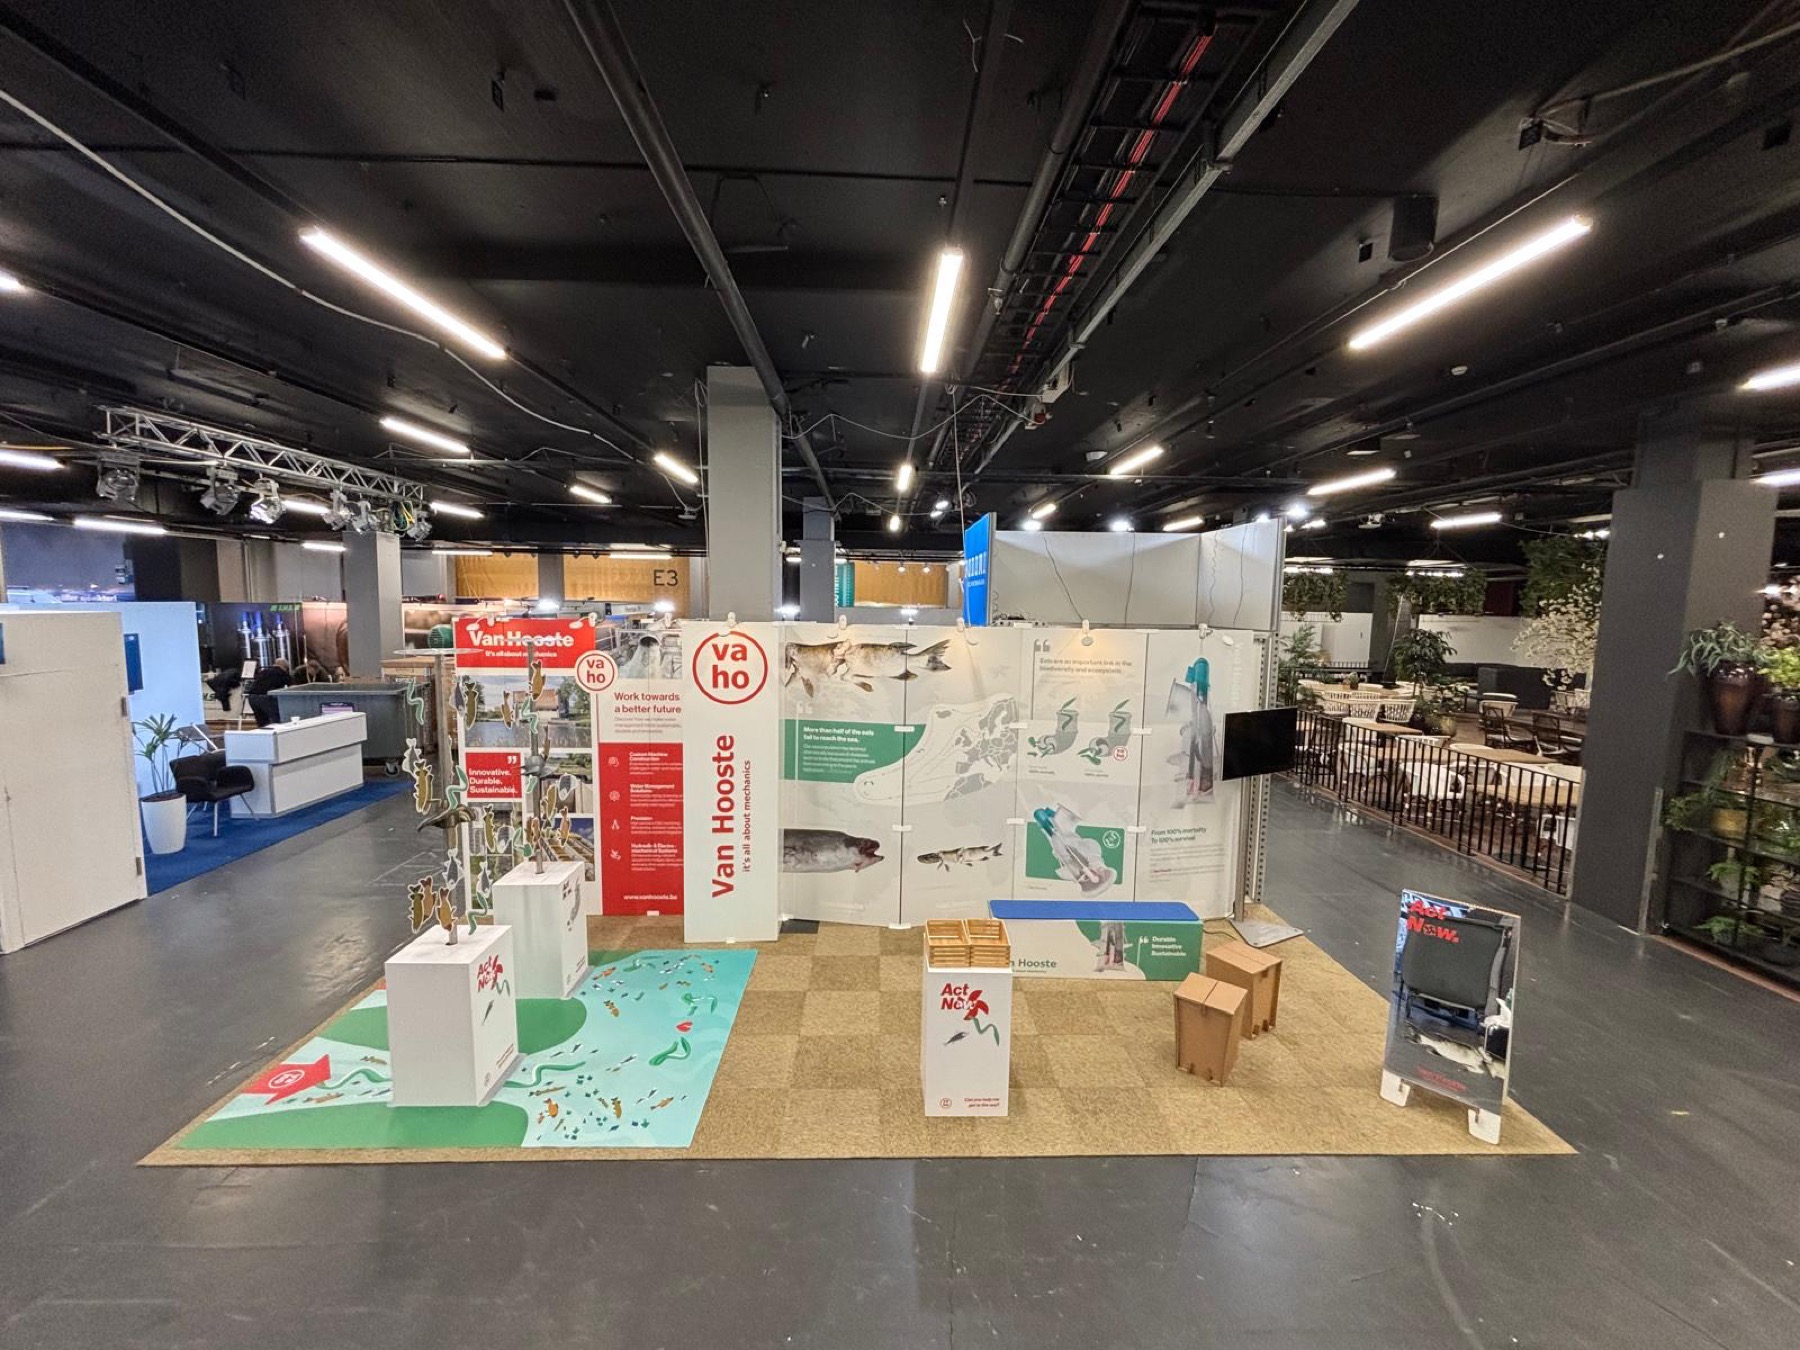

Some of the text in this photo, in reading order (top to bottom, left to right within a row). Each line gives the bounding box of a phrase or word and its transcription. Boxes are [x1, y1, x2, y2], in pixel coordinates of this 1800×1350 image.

[654, 570, 678, 586] E3
[468, 630, 575, 647] Van Hooste
[711, 643, 748, 661] va
[586, 659, 605, 669] va
[586, 670, 606, 683] ho
[712, 664, 750, 690] ho
[614, 692, 681, 701] Work towards
[622, 705, 651, 713] better
[654, 705, 682, 713] future
[468, 768, 512, 776] Innovative.
[469, 777, 504, 785] Durable.
[712, 735, 735, 898] Van Hooste
[742, 760, 751, 872] it's all about mechanics
[1409, 899, 1447, 920] Act
[1018, 959, 1057, 968] Hooste
[941, 983, 969, 996] Act
